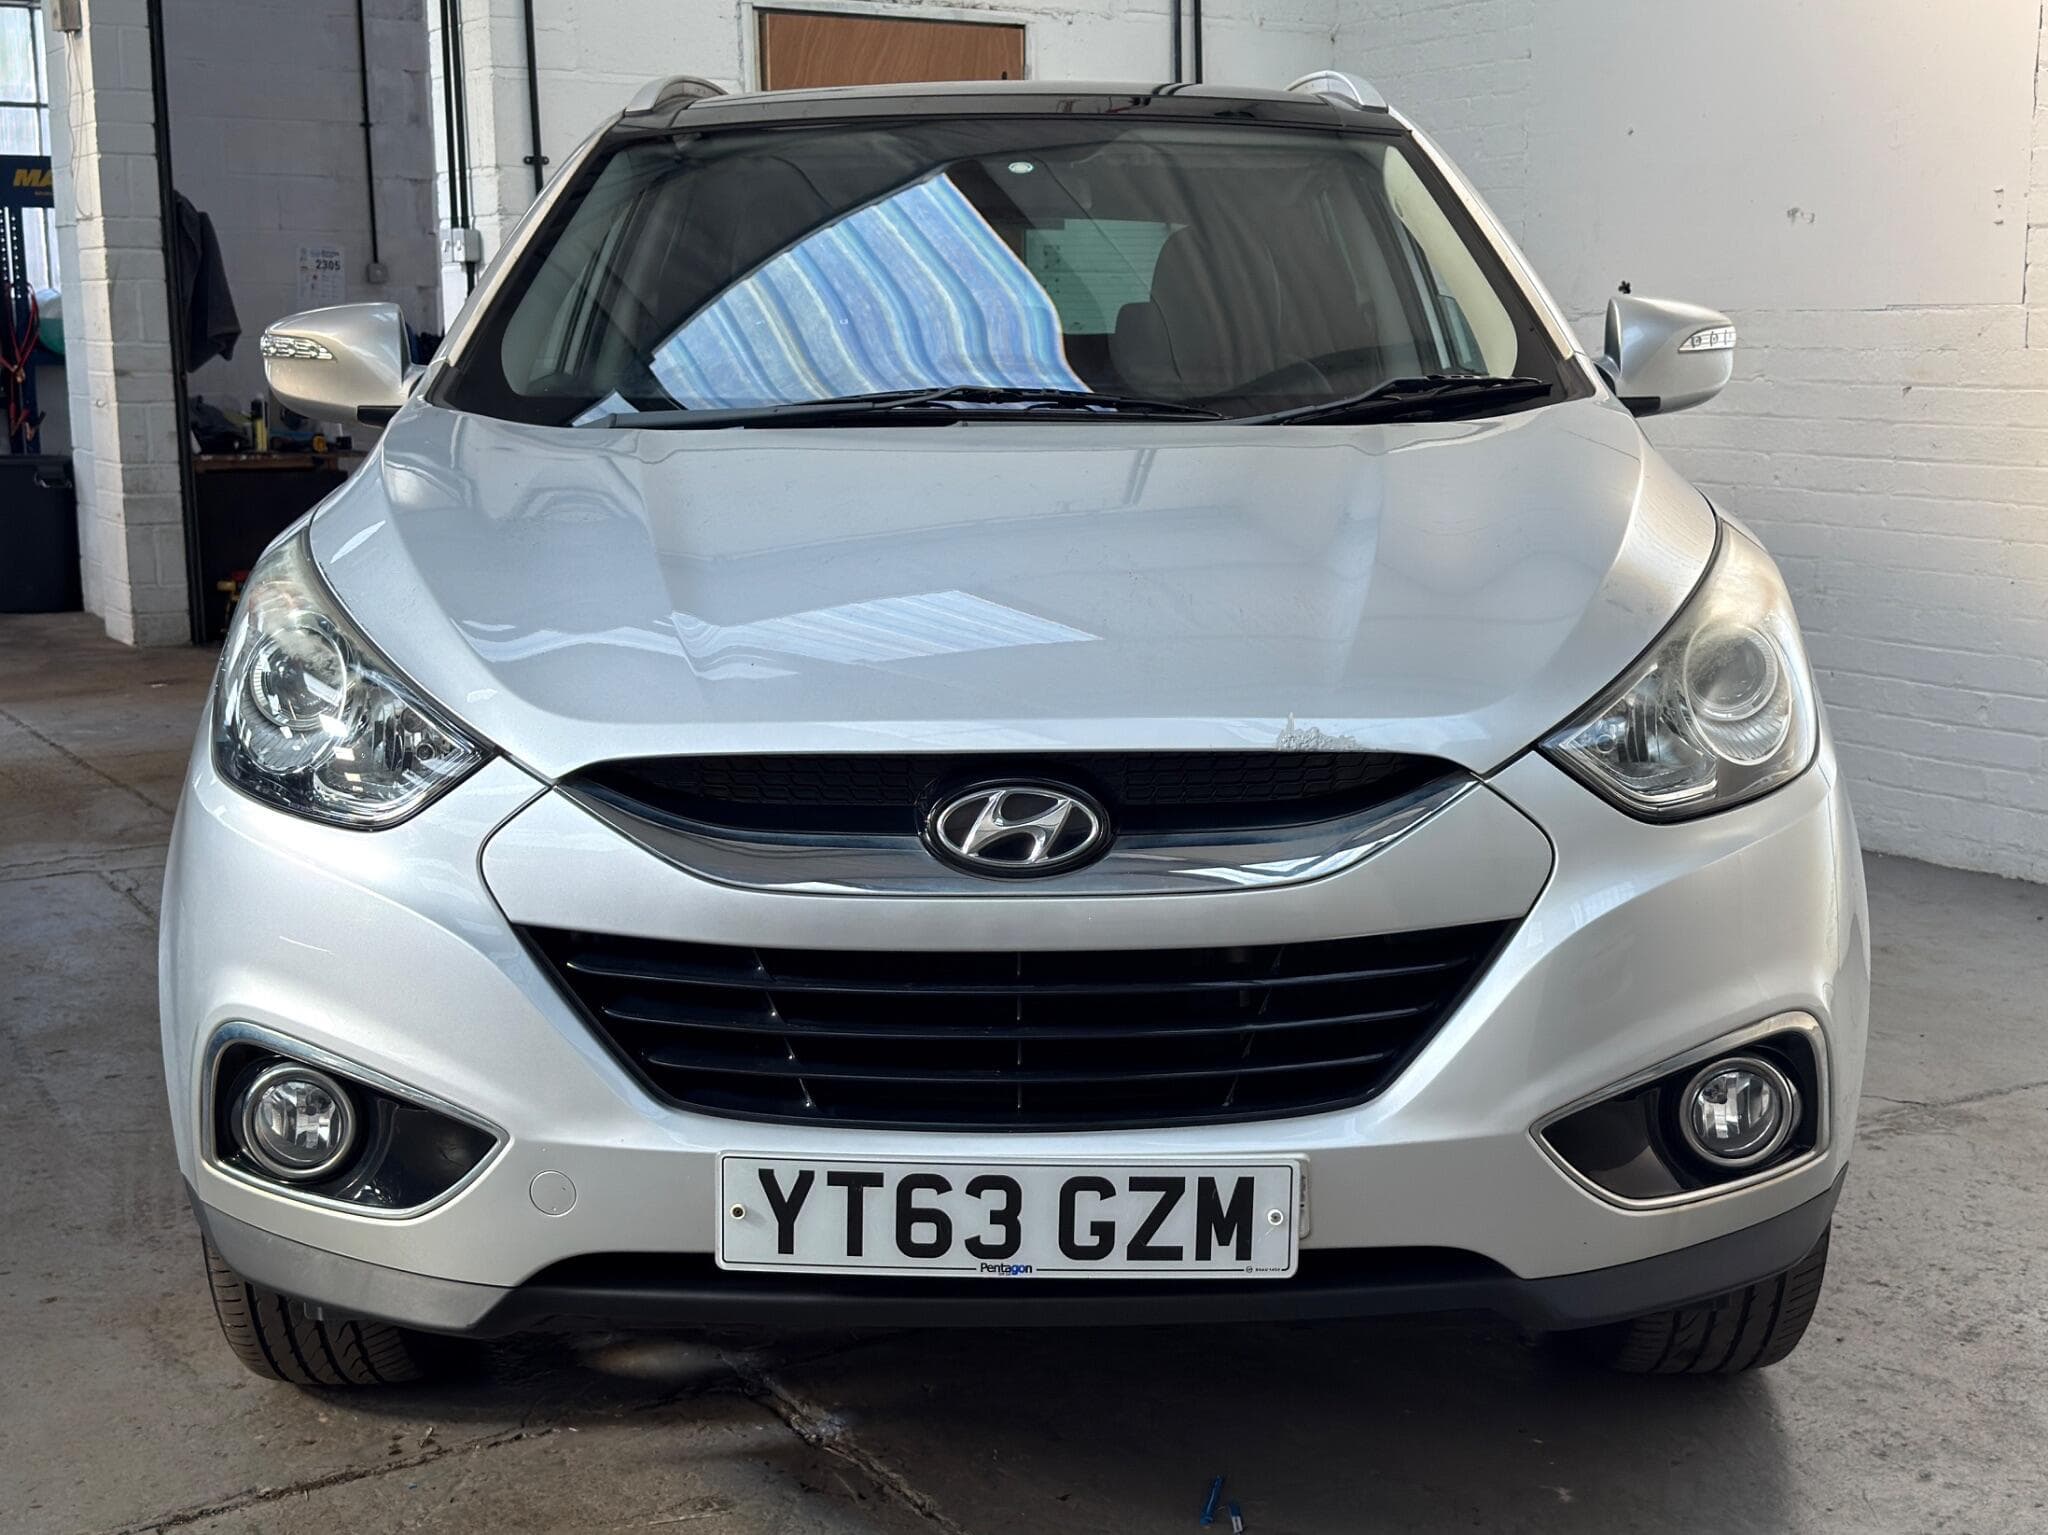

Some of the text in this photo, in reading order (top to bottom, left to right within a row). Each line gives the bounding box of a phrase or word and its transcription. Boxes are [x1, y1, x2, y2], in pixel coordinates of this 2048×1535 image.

[315, 259, 341, 271] 2305
[758, 1168, 1022, 1261] YT63
[1058, 1175, 1255, 1261] GZM
[980, 1262, 1033, 1275] Pentagon
